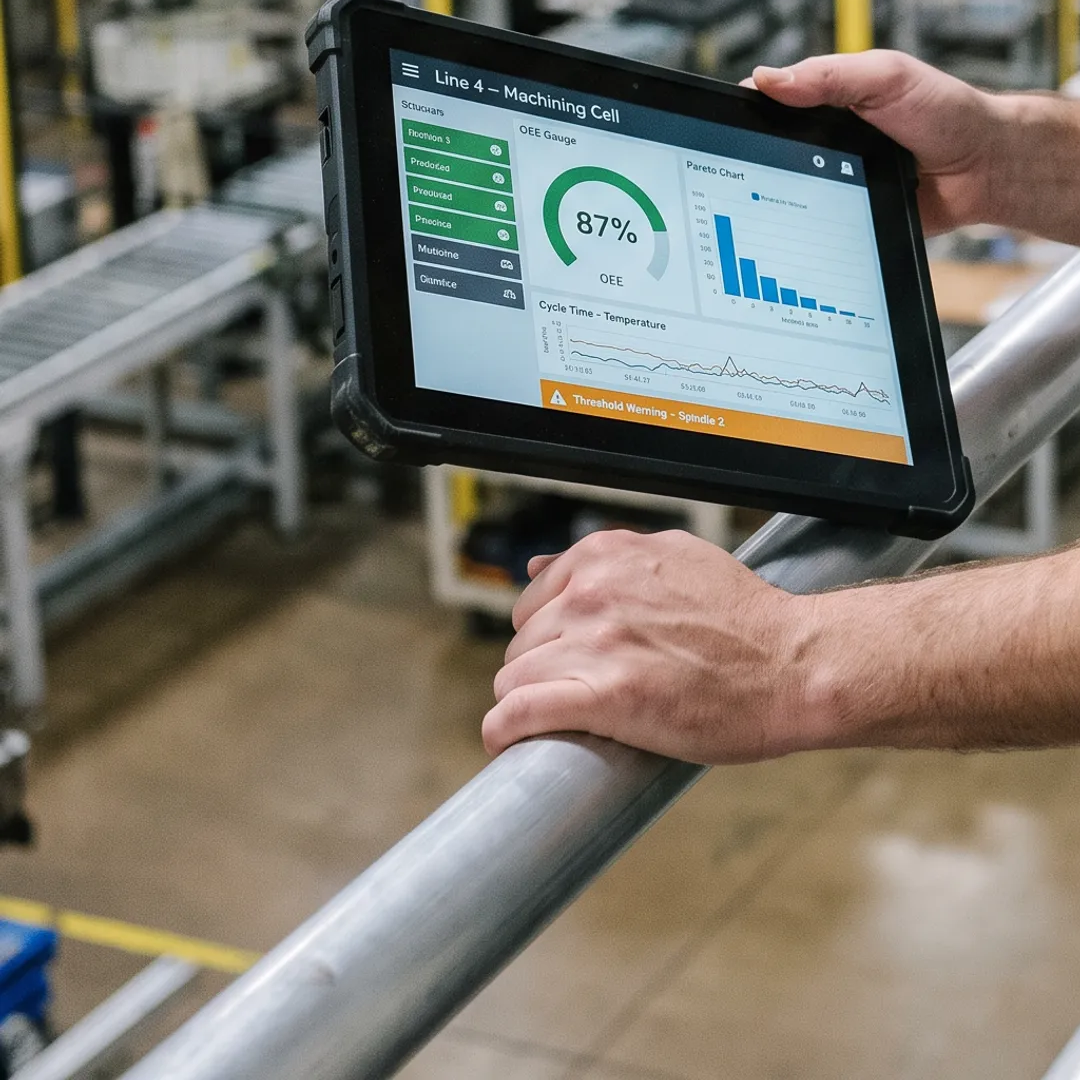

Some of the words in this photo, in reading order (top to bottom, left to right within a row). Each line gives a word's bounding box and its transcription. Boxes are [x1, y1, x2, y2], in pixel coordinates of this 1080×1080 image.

[435, 69, 469, 90] Line
[473, 79, 484, 93] 4
[504, 85, 586, 118] Machining
[590, 104, 620, 123] Cell
[519, 125, 541, 138] OEE
[543, 131, 577, 146] Gauge
[686, 160, 717, 175] Pareto
[719, 167, 745, 181] Chart
[576, 211, 638, 244] 87%
[599, 273, 624, 287] OEE
[538, 300, 567, 314] Cycle
[568, 305, 594, 318] Time
[603, 311, 667, 331] Temperature
[678, 411, 716, 426] Spindle
[718, 417, 725, 427] 2
